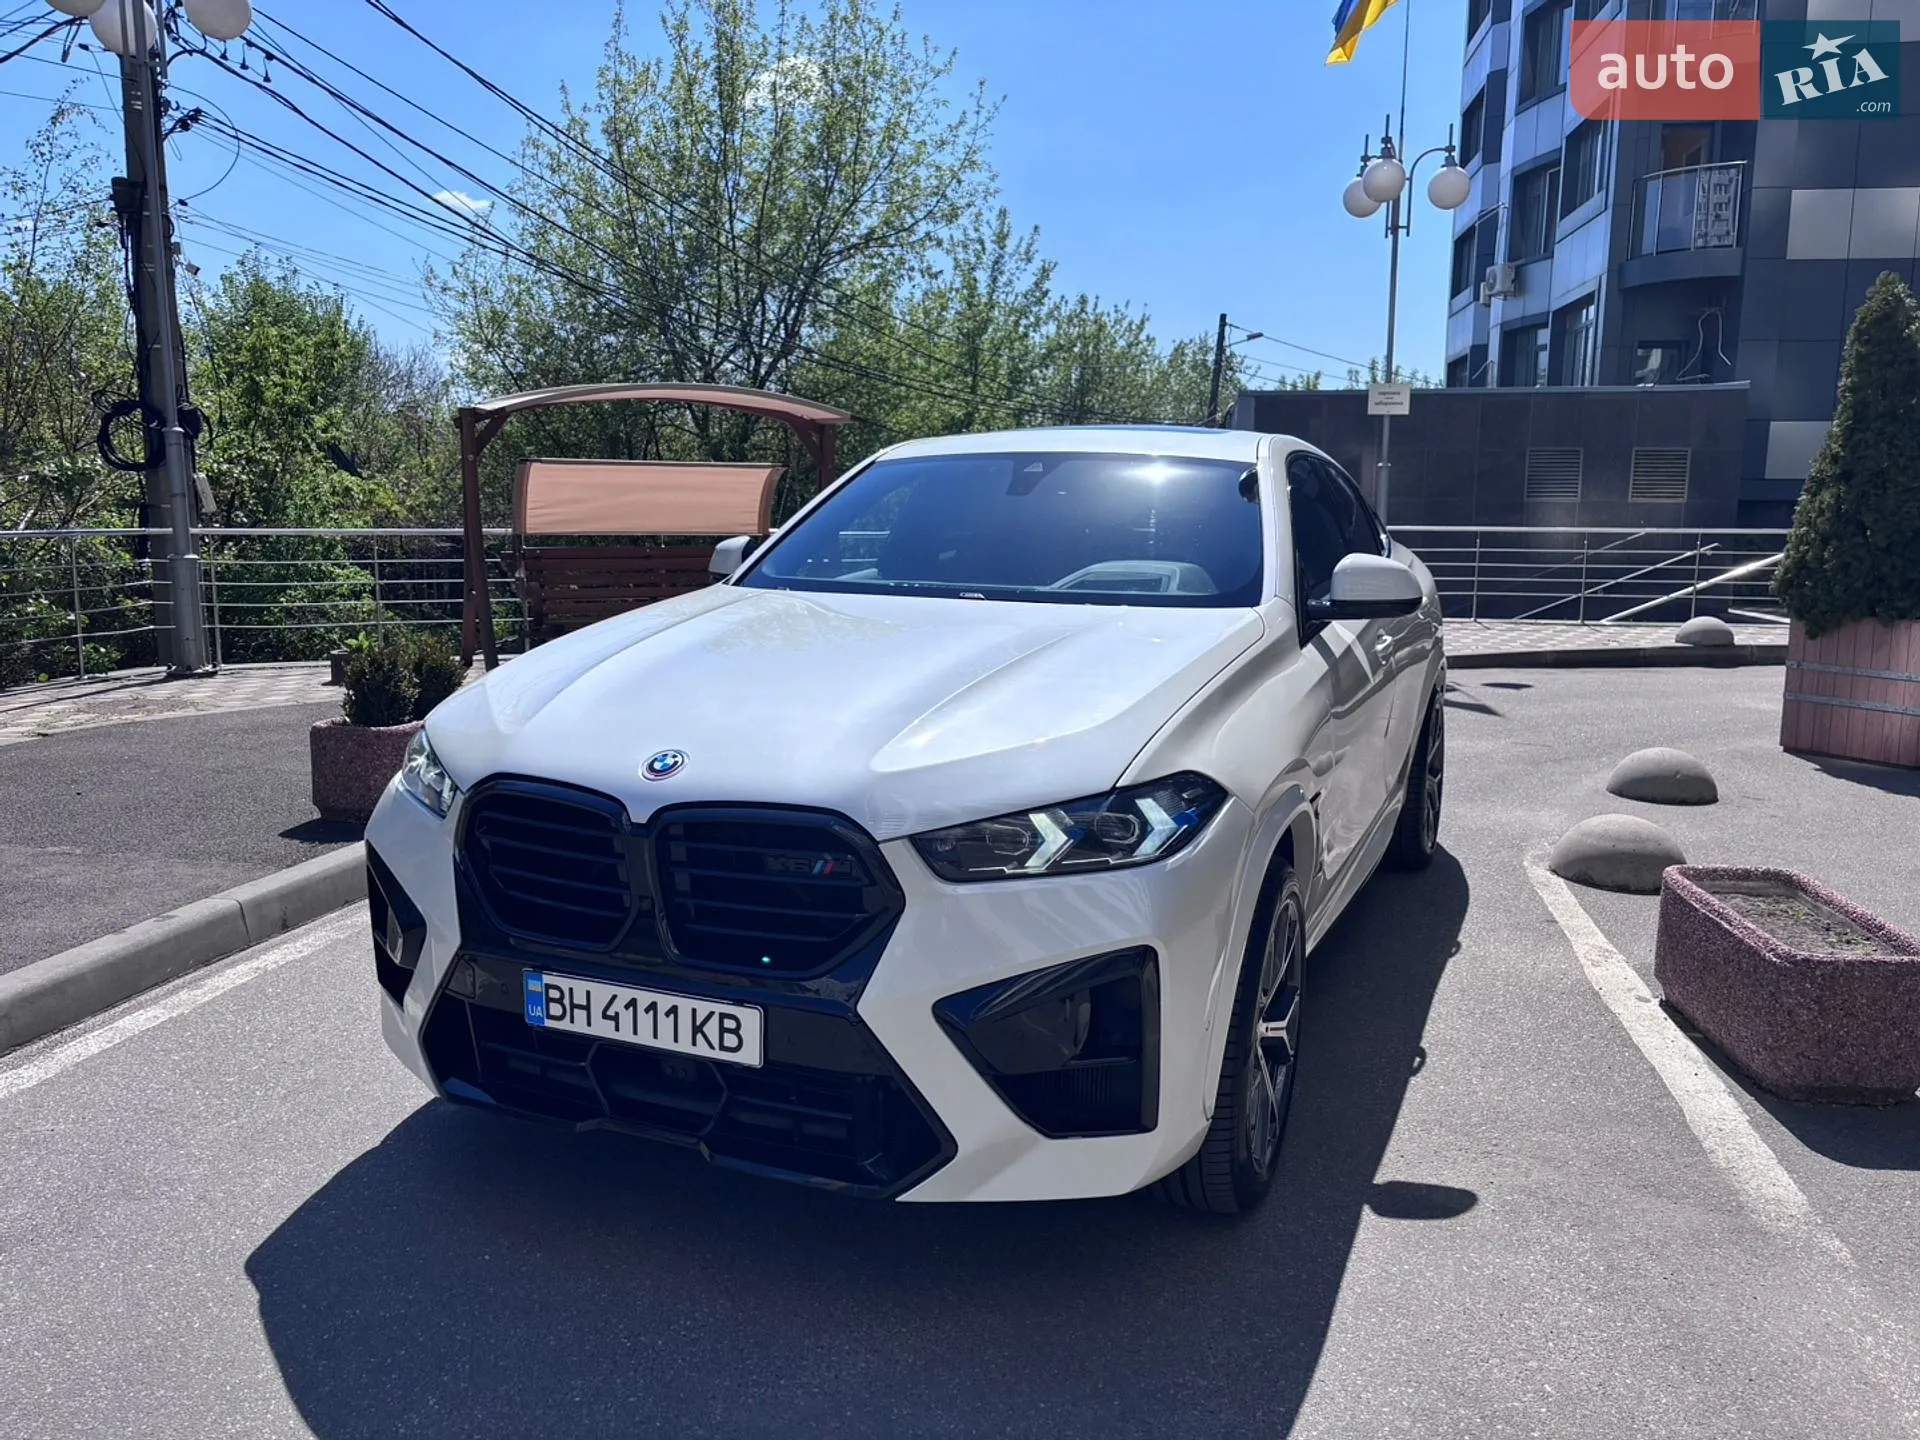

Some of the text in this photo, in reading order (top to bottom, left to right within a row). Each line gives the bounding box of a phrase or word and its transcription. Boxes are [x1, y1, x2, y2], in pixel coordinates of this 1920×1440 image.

[528, 1006, 543, 1018] UA
[544, 983, 744, 1054] BH 4111 KB
